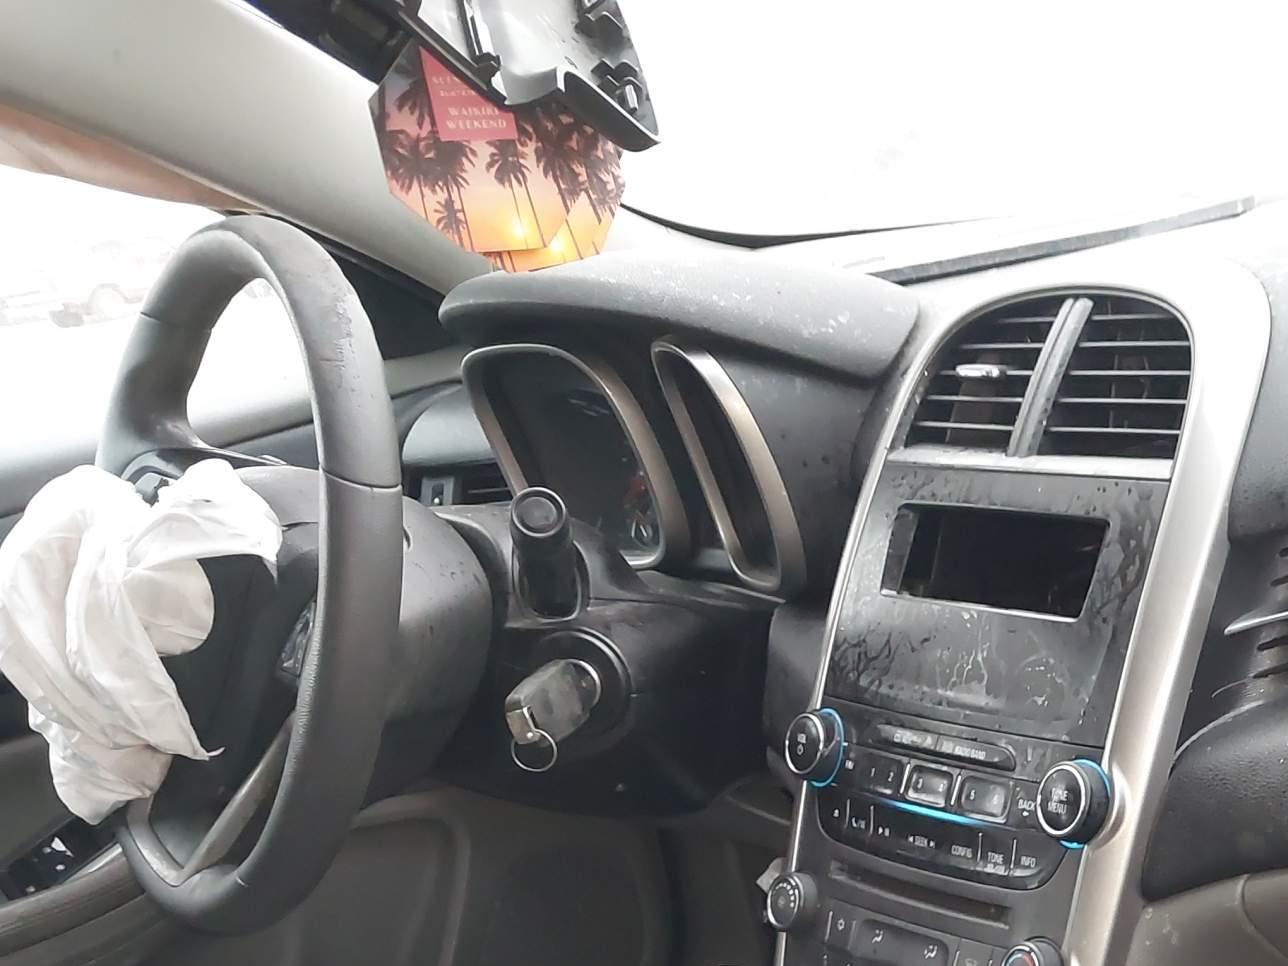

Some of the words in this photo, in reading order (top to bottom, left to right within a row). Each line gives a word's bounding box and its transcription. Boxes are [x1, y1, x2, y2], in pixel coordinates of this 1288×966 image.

[446, 119, 507, 129] WEEKEND
[1018, 798, 1036, 812] BACK
[1047, 800, 1068, 814] MENU
[1020, 855, 1037, 868] INFO
